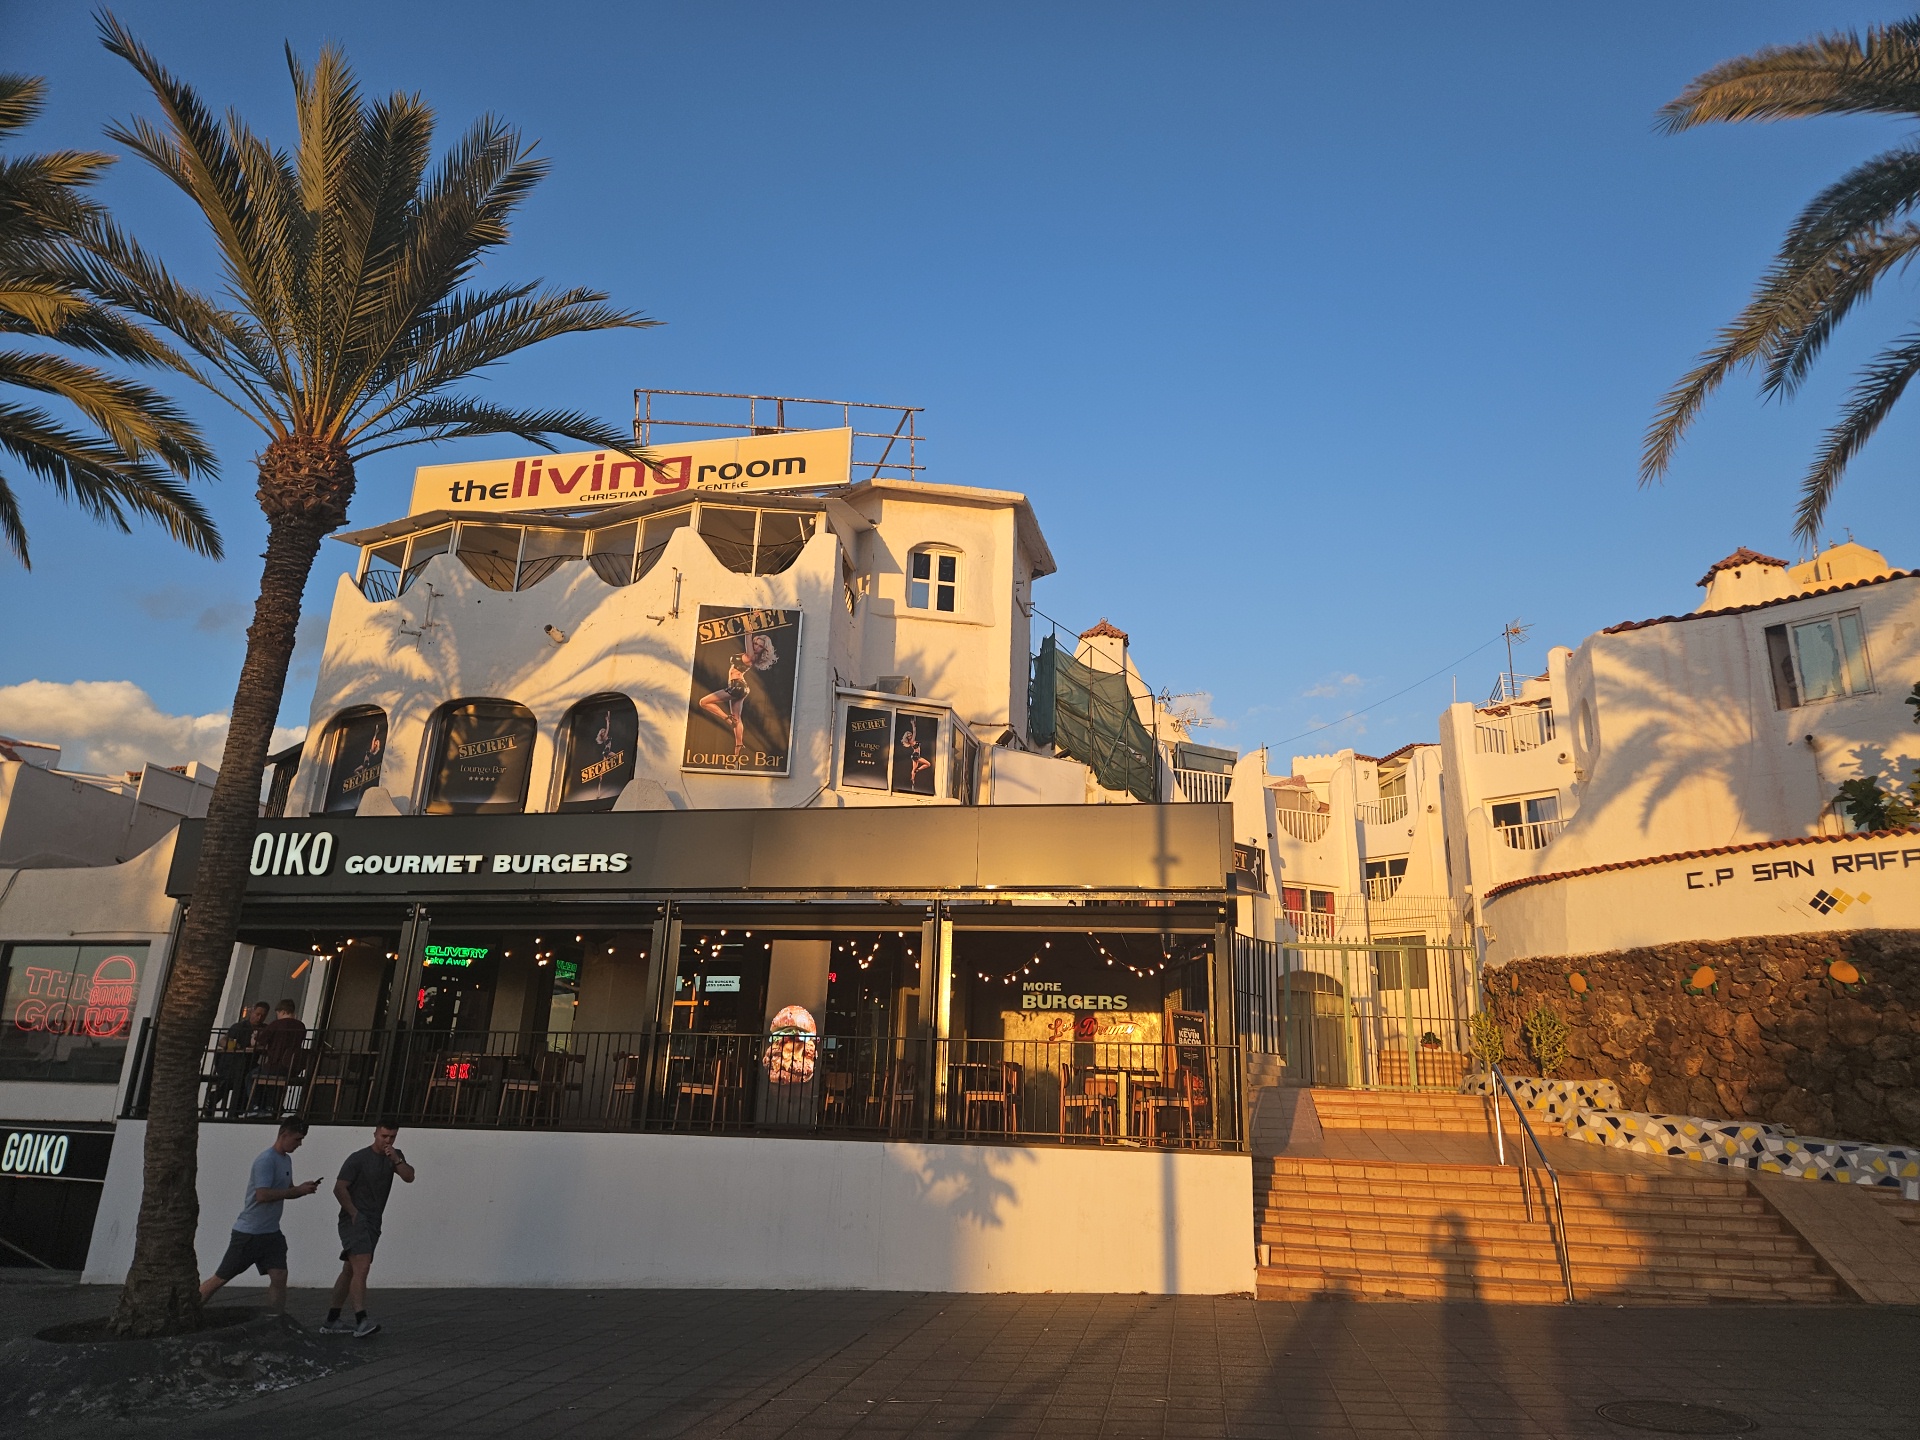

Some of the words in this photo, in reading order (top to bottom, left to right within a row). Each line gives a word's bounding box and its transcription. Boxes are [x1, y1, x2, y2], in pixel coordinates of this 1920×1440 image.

[697, 457, 806, 483] room
[579, 490, 648, 503] CHRISTIAN
[698, 610, 788, 642] SECRET
[852, 718, 885, 731] SECRET
[459, 736, 516, 758] SECRET
[854, 740, 880, 751] Lounge
[860, 750, 872, 758] Bar
[581, 753, 625, 783] SECRET
[686, 749, 749, 770] Lounge
[755, 751, 784, 768] Bar
[459, 764, 490, 775] Lounge
[491, 765, 507, 774] Bar
[249, 831, 334, 876] OIKO
[344, 854, 484, 874] GOURMET
[492, 853, 629, 874] BURGERS
[1752, 859, 1815, 882] SAN
[425, 945, 488, 959] ELIVERY
[1022, 981, 1062, 992] MORE
[88, 985, 133, 1007] GOIKO
[1022, 994, 1128, 1010] BURGERS
[1178, 1029, 1200, 1040] KEVIN
[1, 1132, 69, 1175] GOIKO
